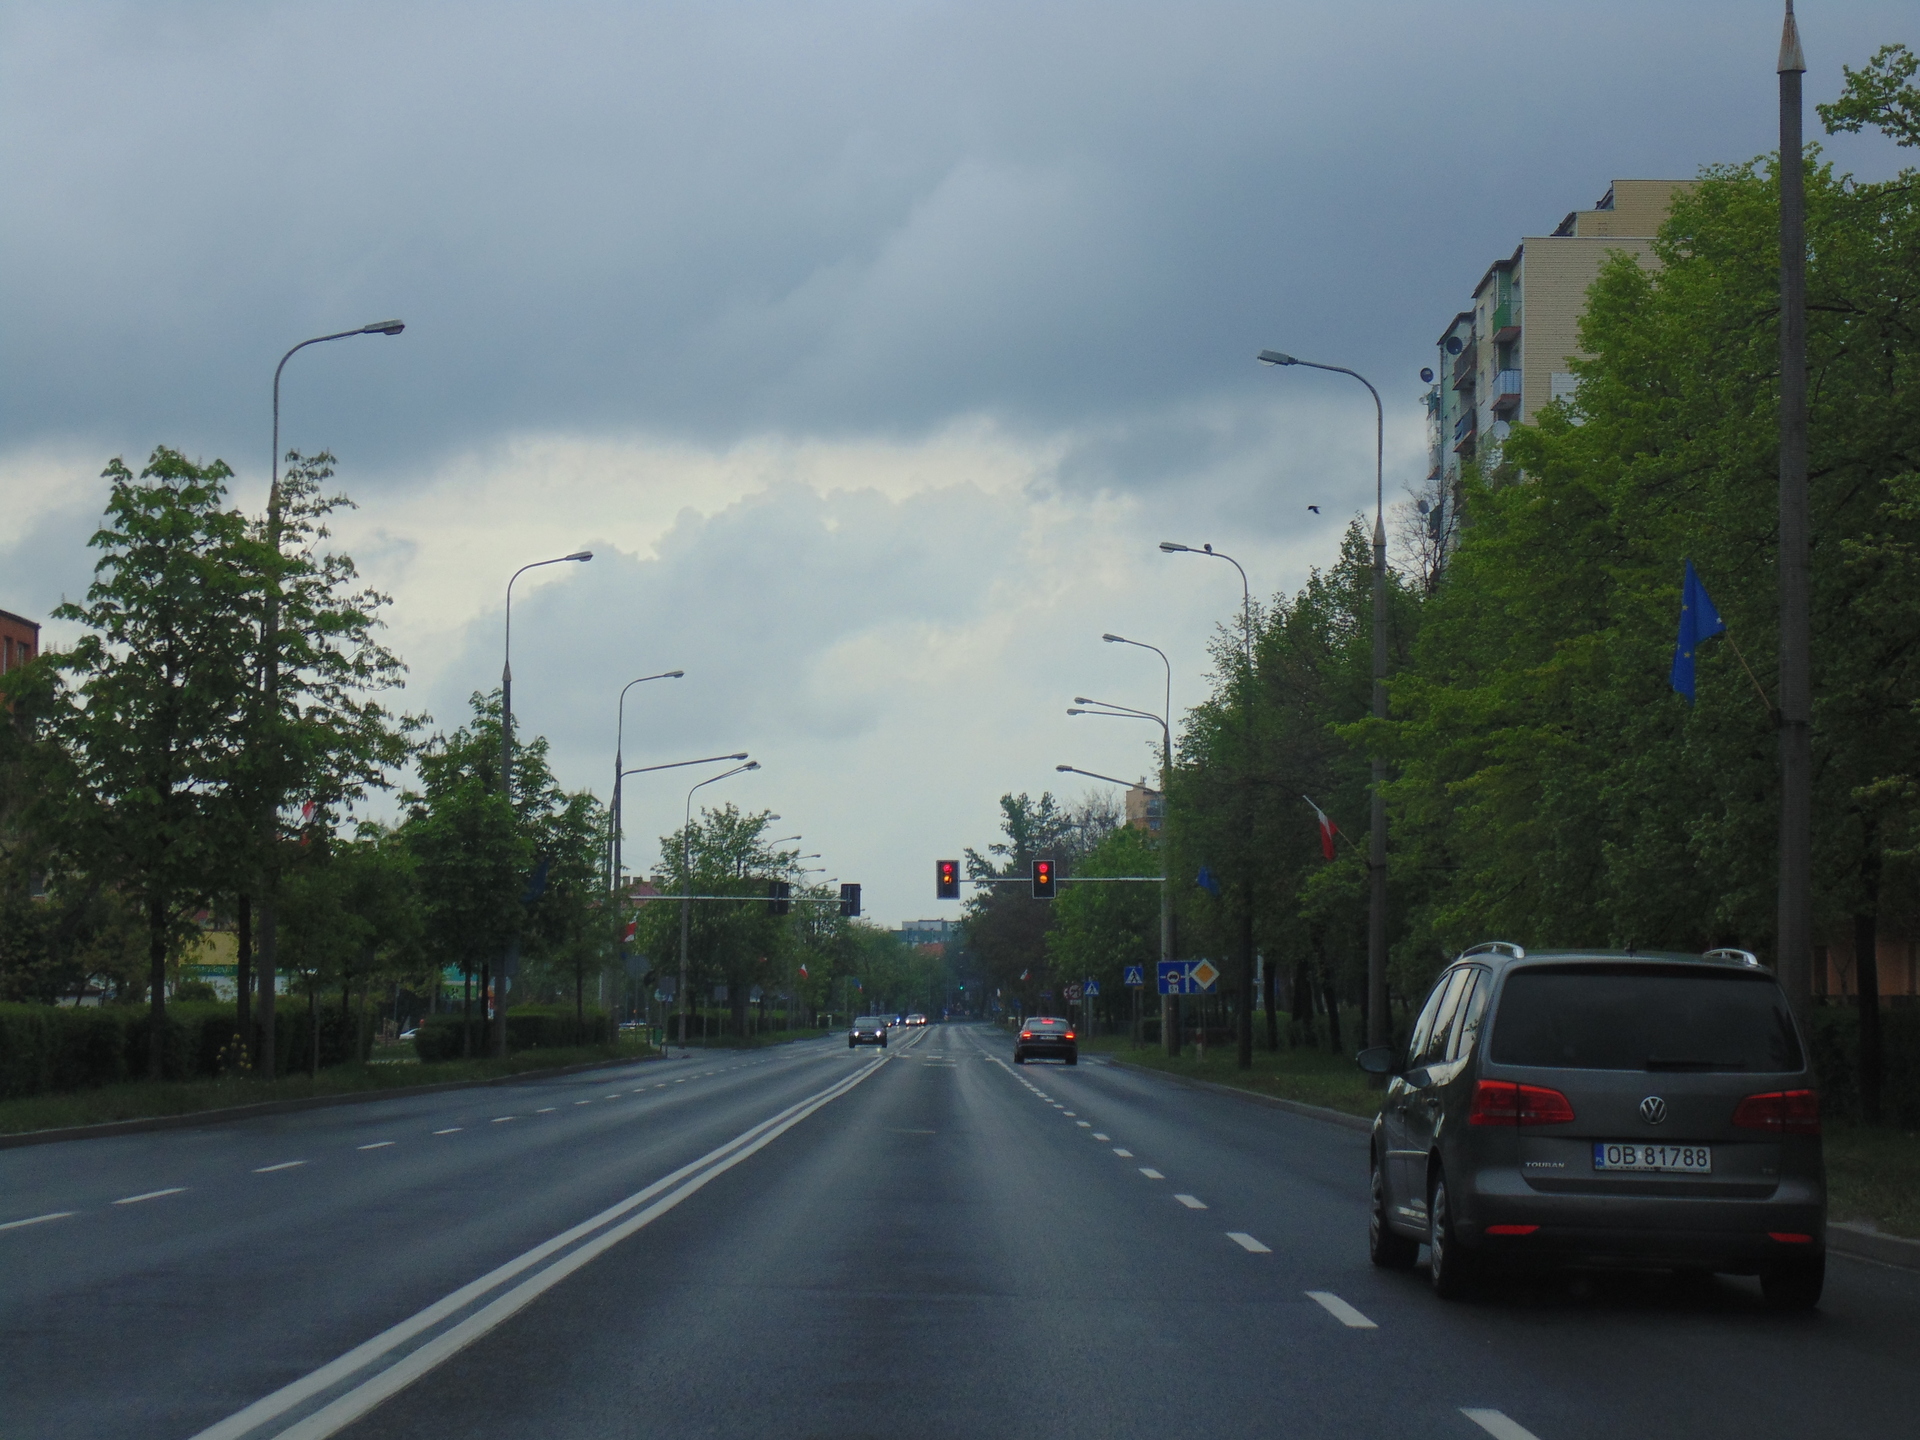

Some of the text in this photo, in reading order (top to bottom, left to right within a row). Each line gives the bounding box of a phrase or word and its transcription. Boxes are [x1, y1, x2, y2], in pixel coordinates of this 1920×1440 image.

[1607, 1146, 1708, 1168] OB 81788
[1525, 1161, 1566, 1169] TOURAN
